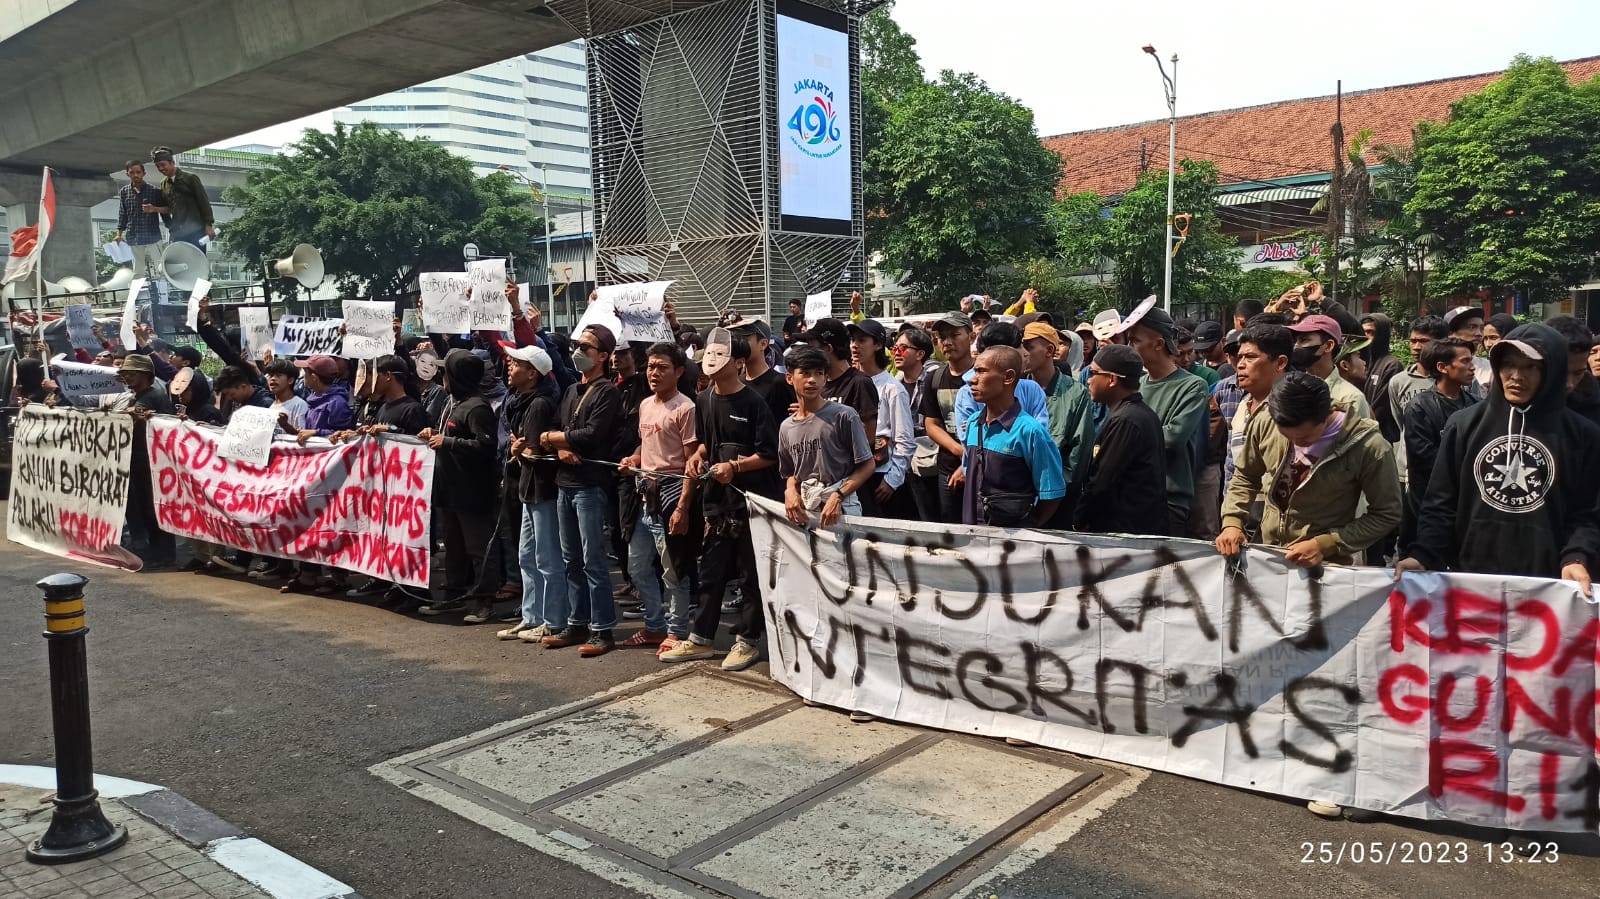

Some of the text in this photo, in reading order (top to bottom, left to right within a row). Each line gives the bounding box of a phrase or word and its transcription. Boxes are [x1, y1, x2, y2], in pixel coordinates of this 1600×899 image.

[793, 79, 833, 102] JAKARTA
[787, 104, 841, 142] 496
[1255, 243, 1299, 262] Mbok
[52, 414, 131, 464] TANGKAP
[1485, 442, 1546, 467] CONVERSE
[60, 460, 130, 507] BIROKRAT
[1486, 486, 1540, 505] ALL STAR
[12, 488, 57, 536] PELAKU
[768, 601, 1362, 773] INTEGRITAS
[1428, 739, 1559, 821] RI
